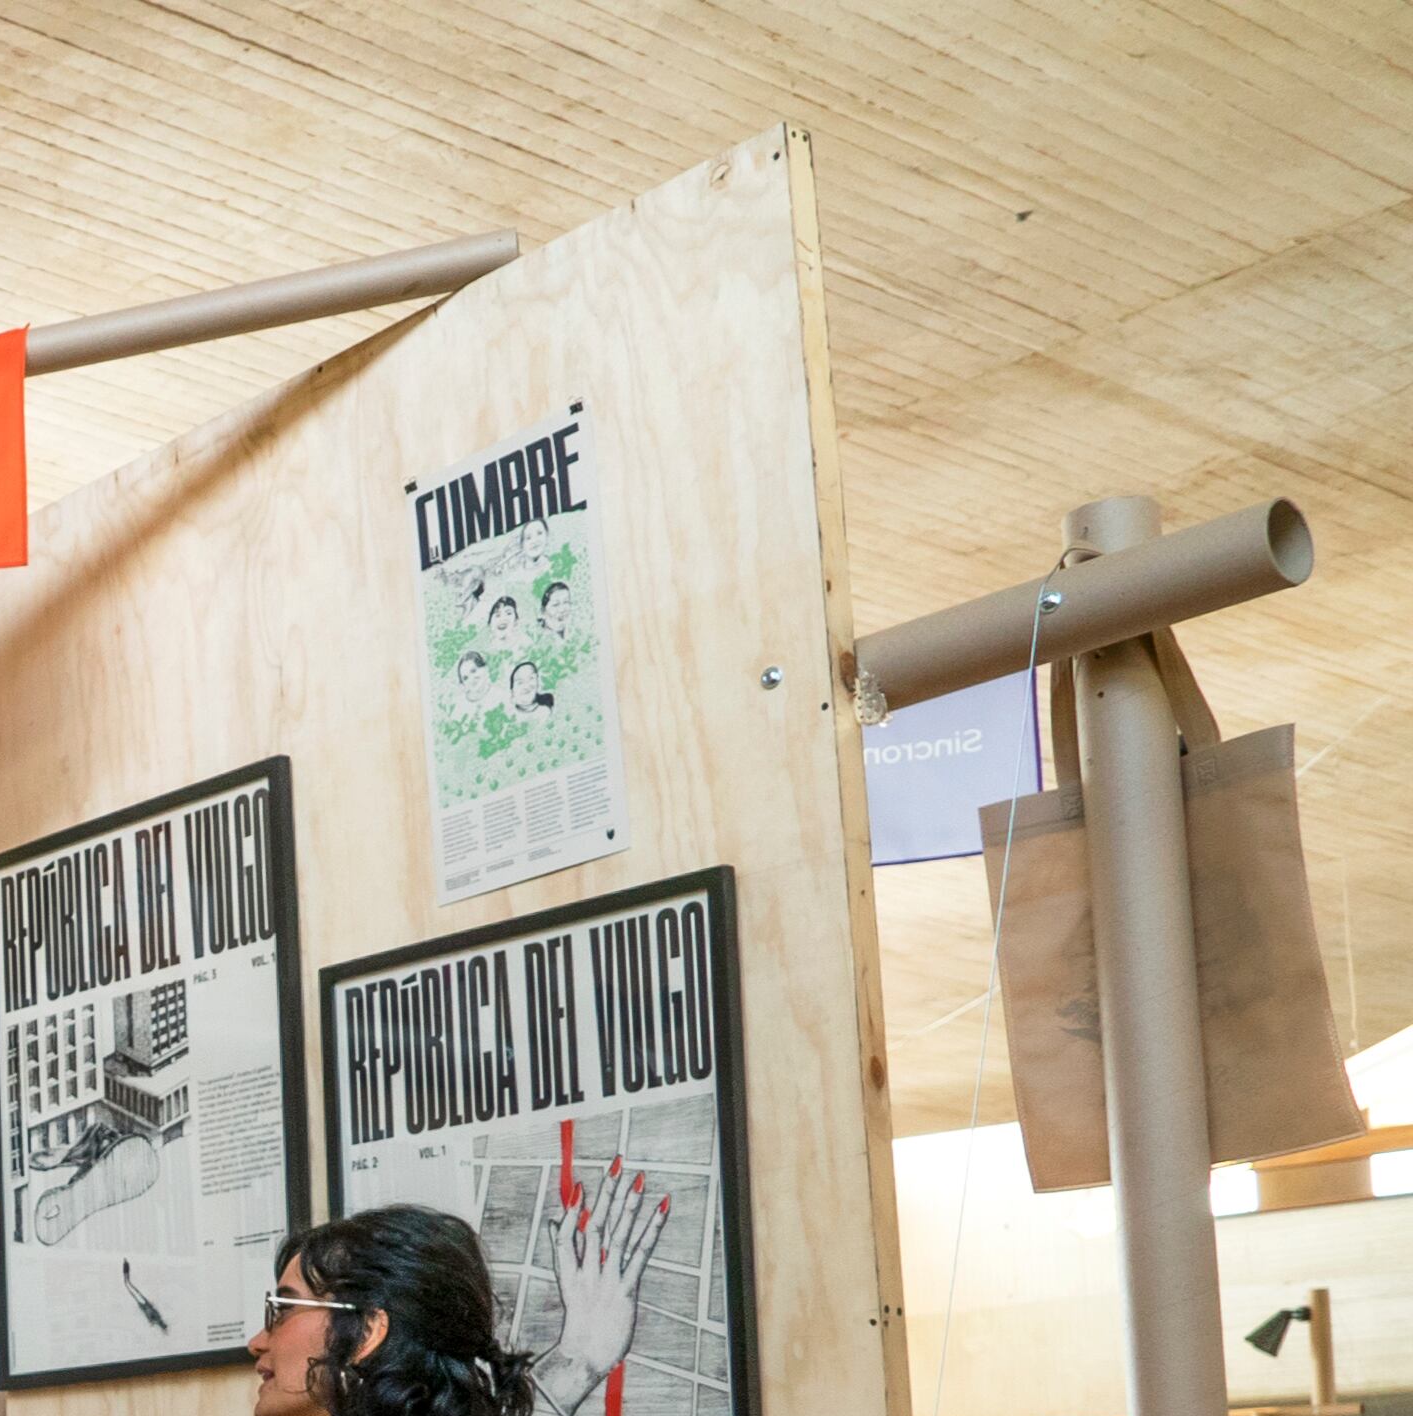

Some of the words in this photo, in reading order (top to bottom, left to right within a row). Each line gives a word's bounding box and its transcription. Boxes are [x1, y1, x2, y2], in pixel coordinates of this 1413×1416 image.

[414, 422, 587, 571] CUMBRE
[0, 837, 131, 1013] REPÚBLICA
[135, 820, 180, 974] DEL
[184, 788, 276, 959] VULGO
[345, 950, 519, 1145] REPÚBLICA
[523, 934, 585, 1109] DEL
[589, 901, 713, 1096] VULGO
